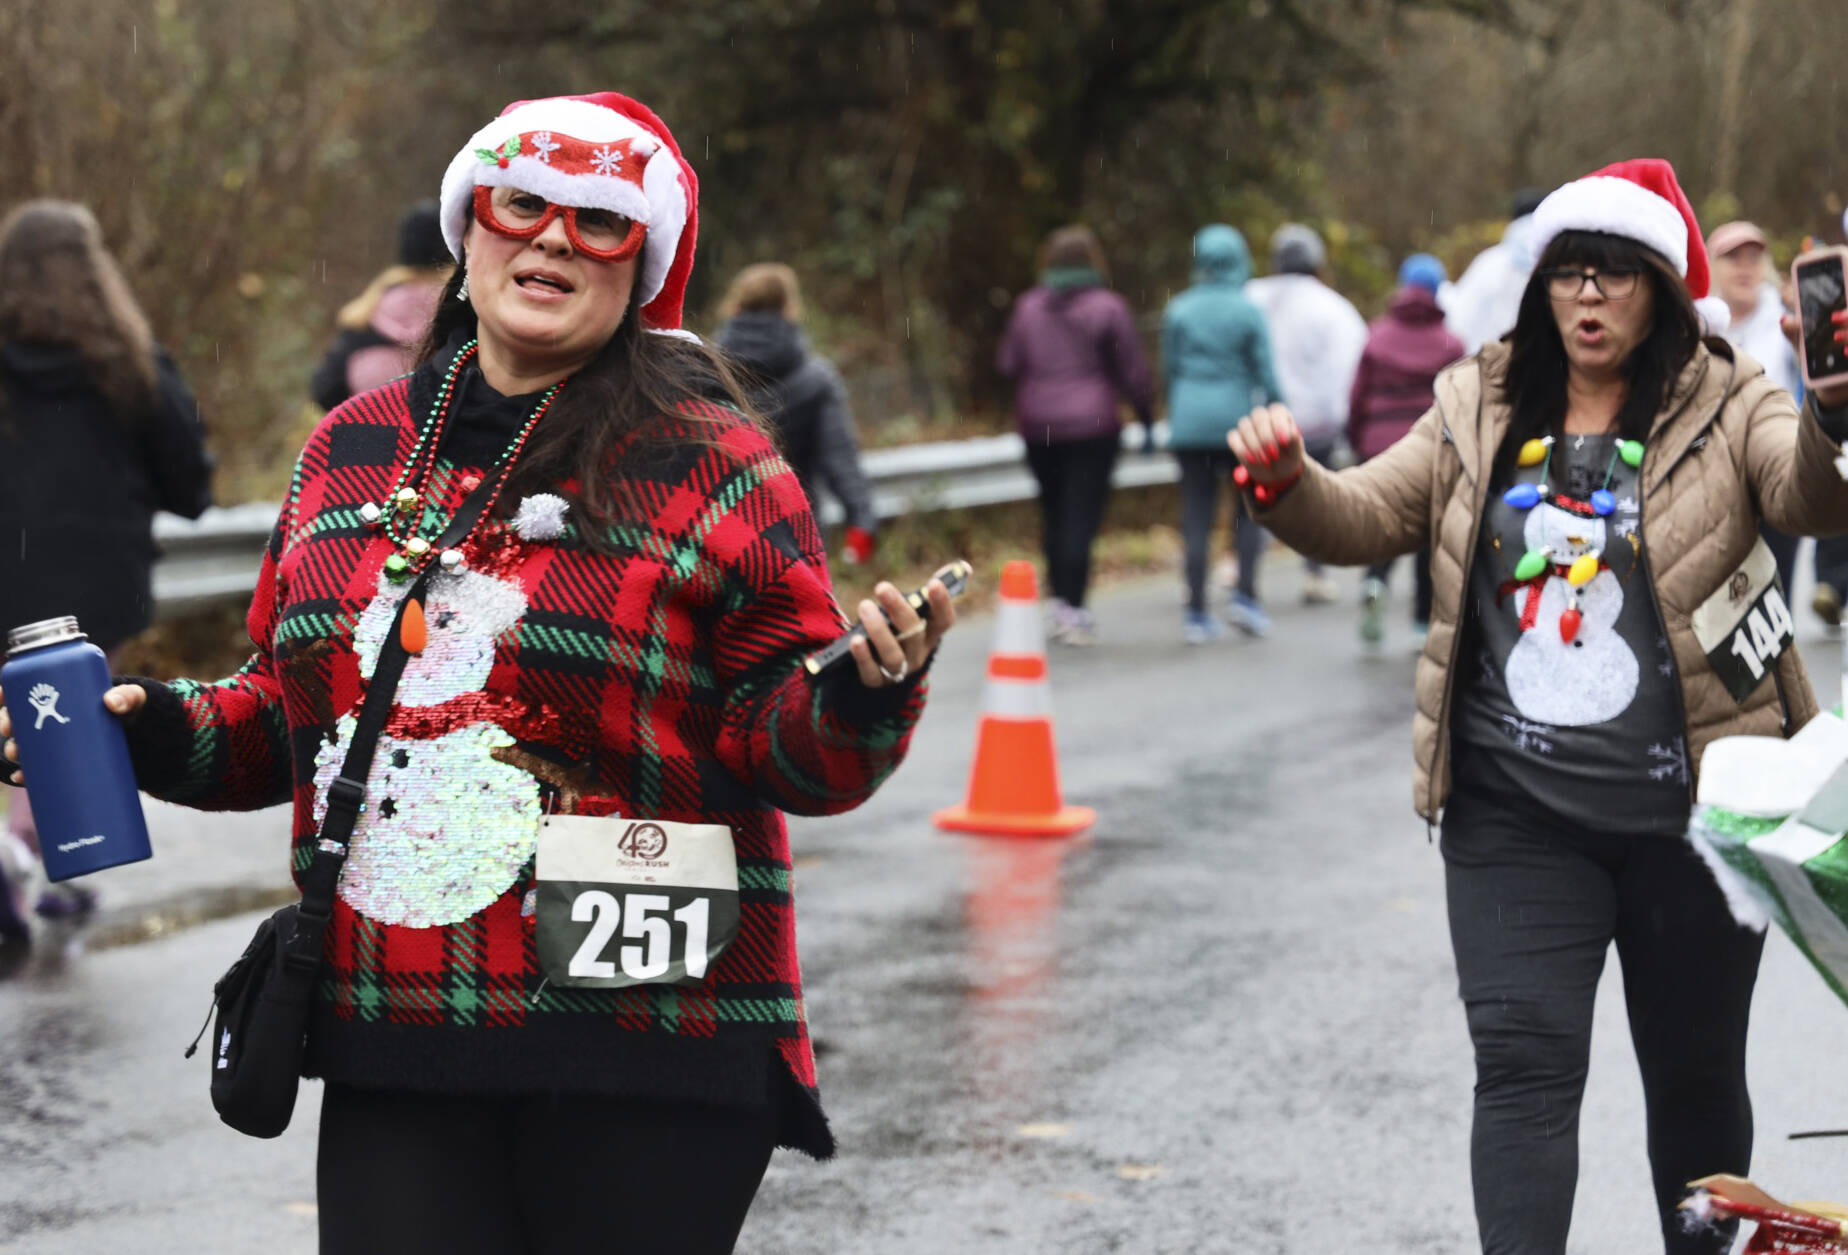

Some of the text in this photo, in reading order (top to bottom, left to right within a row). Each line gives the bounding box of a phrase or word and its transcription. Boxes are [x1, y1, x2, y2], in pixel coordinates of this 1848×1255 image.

[1731, 585, 1793, 680] 144
[645, 860, 670, 868] RUSH
[568, 890, 709, 979] 251
